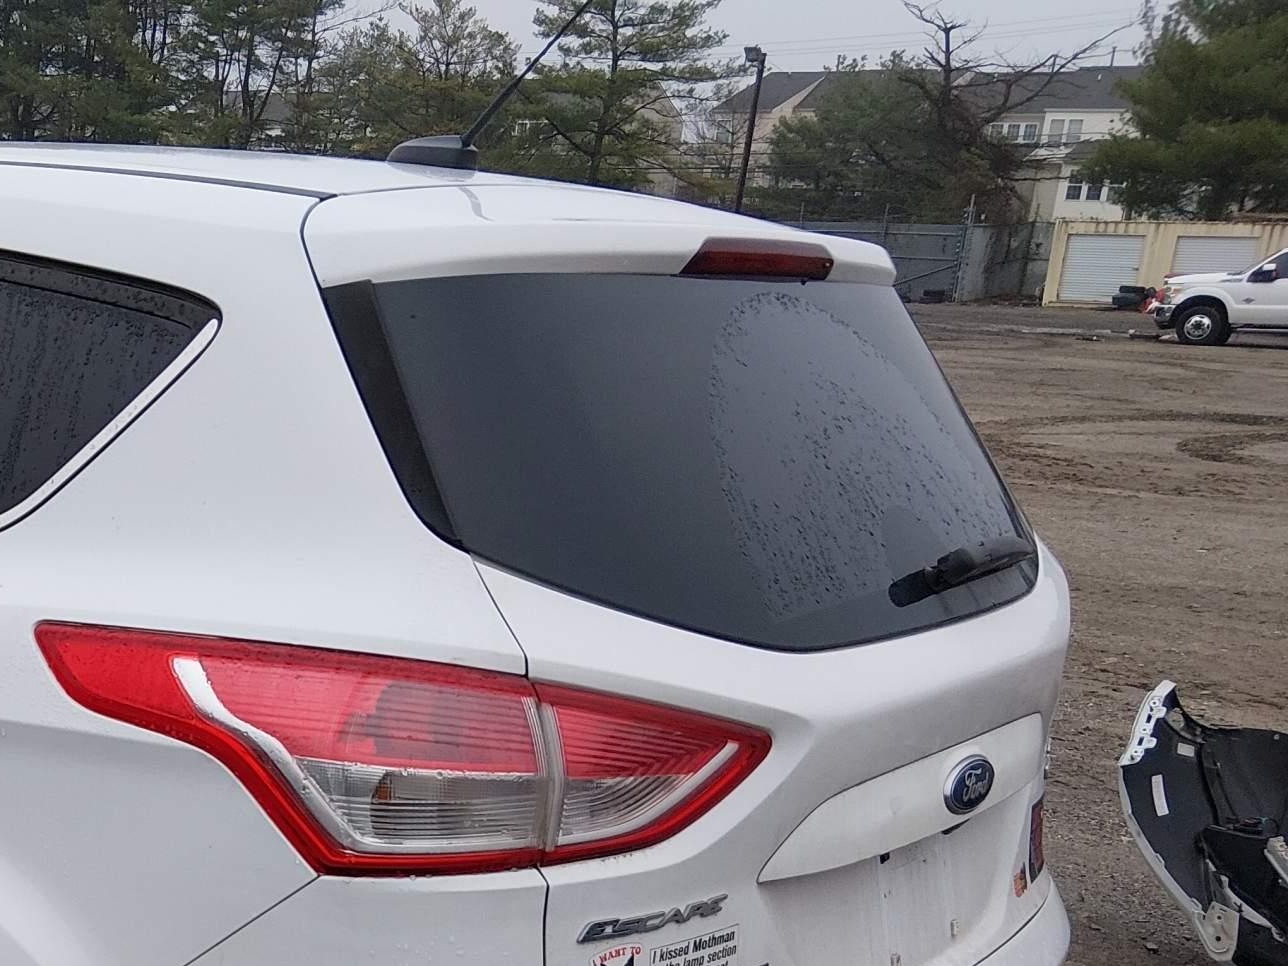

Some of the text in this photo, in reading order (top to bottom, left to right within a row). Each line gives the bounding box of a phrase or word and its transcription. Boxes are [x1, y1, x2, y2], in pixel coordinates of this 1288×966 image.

[962, 767, 990, 801] Ford
[576, 893, 728, 944] ESCAPE
[599, 947, 627, 962] WANT
[652, 931, 736, 964] I kissed Mothman
[707, 944, 737, 963] section
